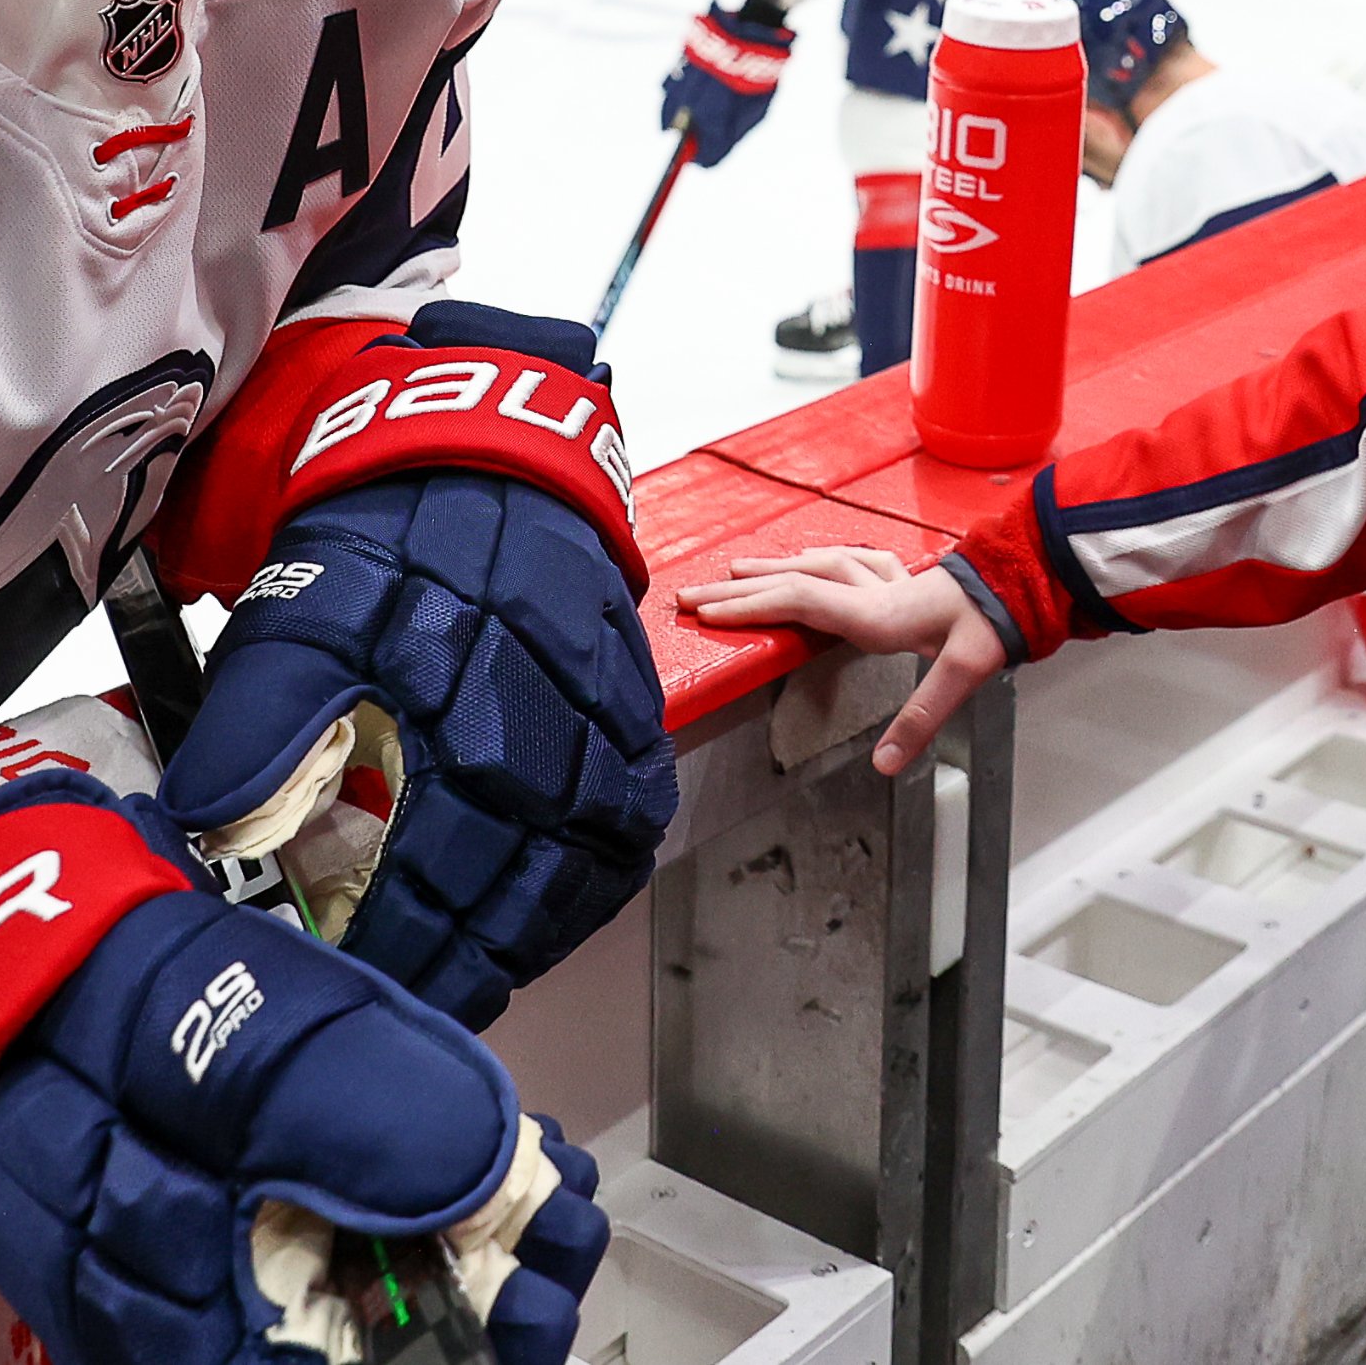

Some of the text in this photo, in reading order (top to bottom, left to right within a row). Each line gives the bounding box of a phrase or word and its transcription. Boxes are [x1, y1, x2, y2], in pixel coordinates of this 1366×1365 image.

[121, 12, 171, 70] NHL
[261, 8, 370, 233] A
[944, 273, 997, 297] DRINK
[290, 361, 635, 534] BAUE
